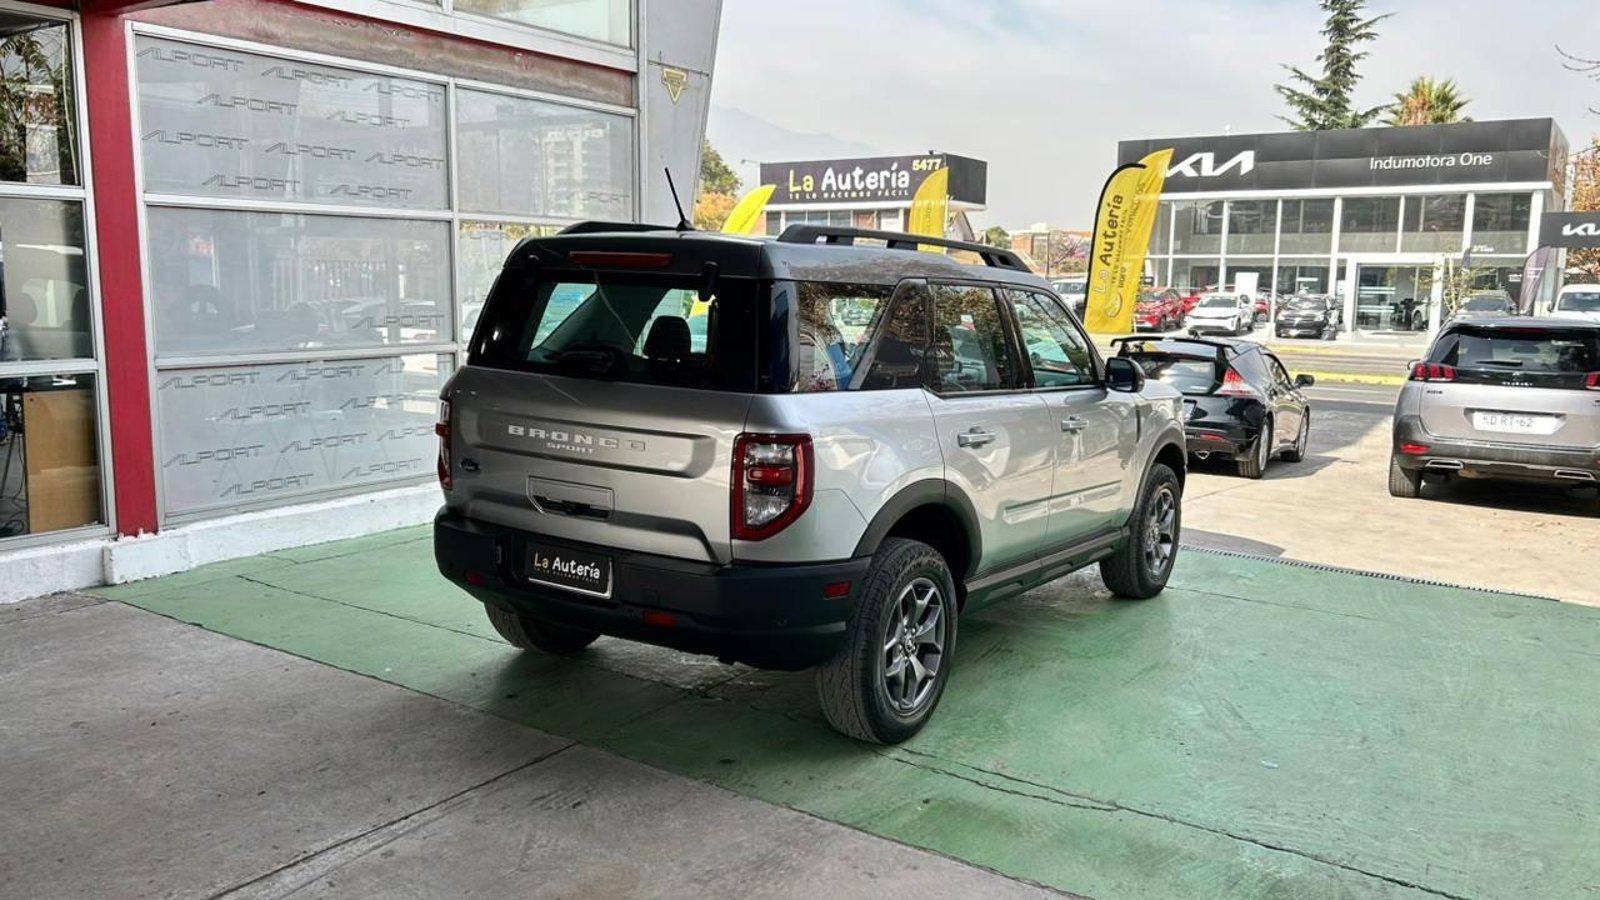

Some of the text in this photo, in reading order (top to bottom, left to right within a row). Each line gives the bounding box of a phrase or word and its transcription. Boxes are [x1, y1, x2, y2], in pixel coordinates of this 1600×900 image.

[912, 159, 942, 172] 5477
[1369, 152, 1493, 171] Indumotora One
[789, 163, 910, 193] La Autería
[1100, 194, 1124, 267] Autería
[158, 372, 261, 390] ALPORT
[508, 424, 646, 452] BRONCO
[546, 442, 594, 454] SPORT
[534, 552, 549, 569] La
[552, 556, 601, 579] Autería
